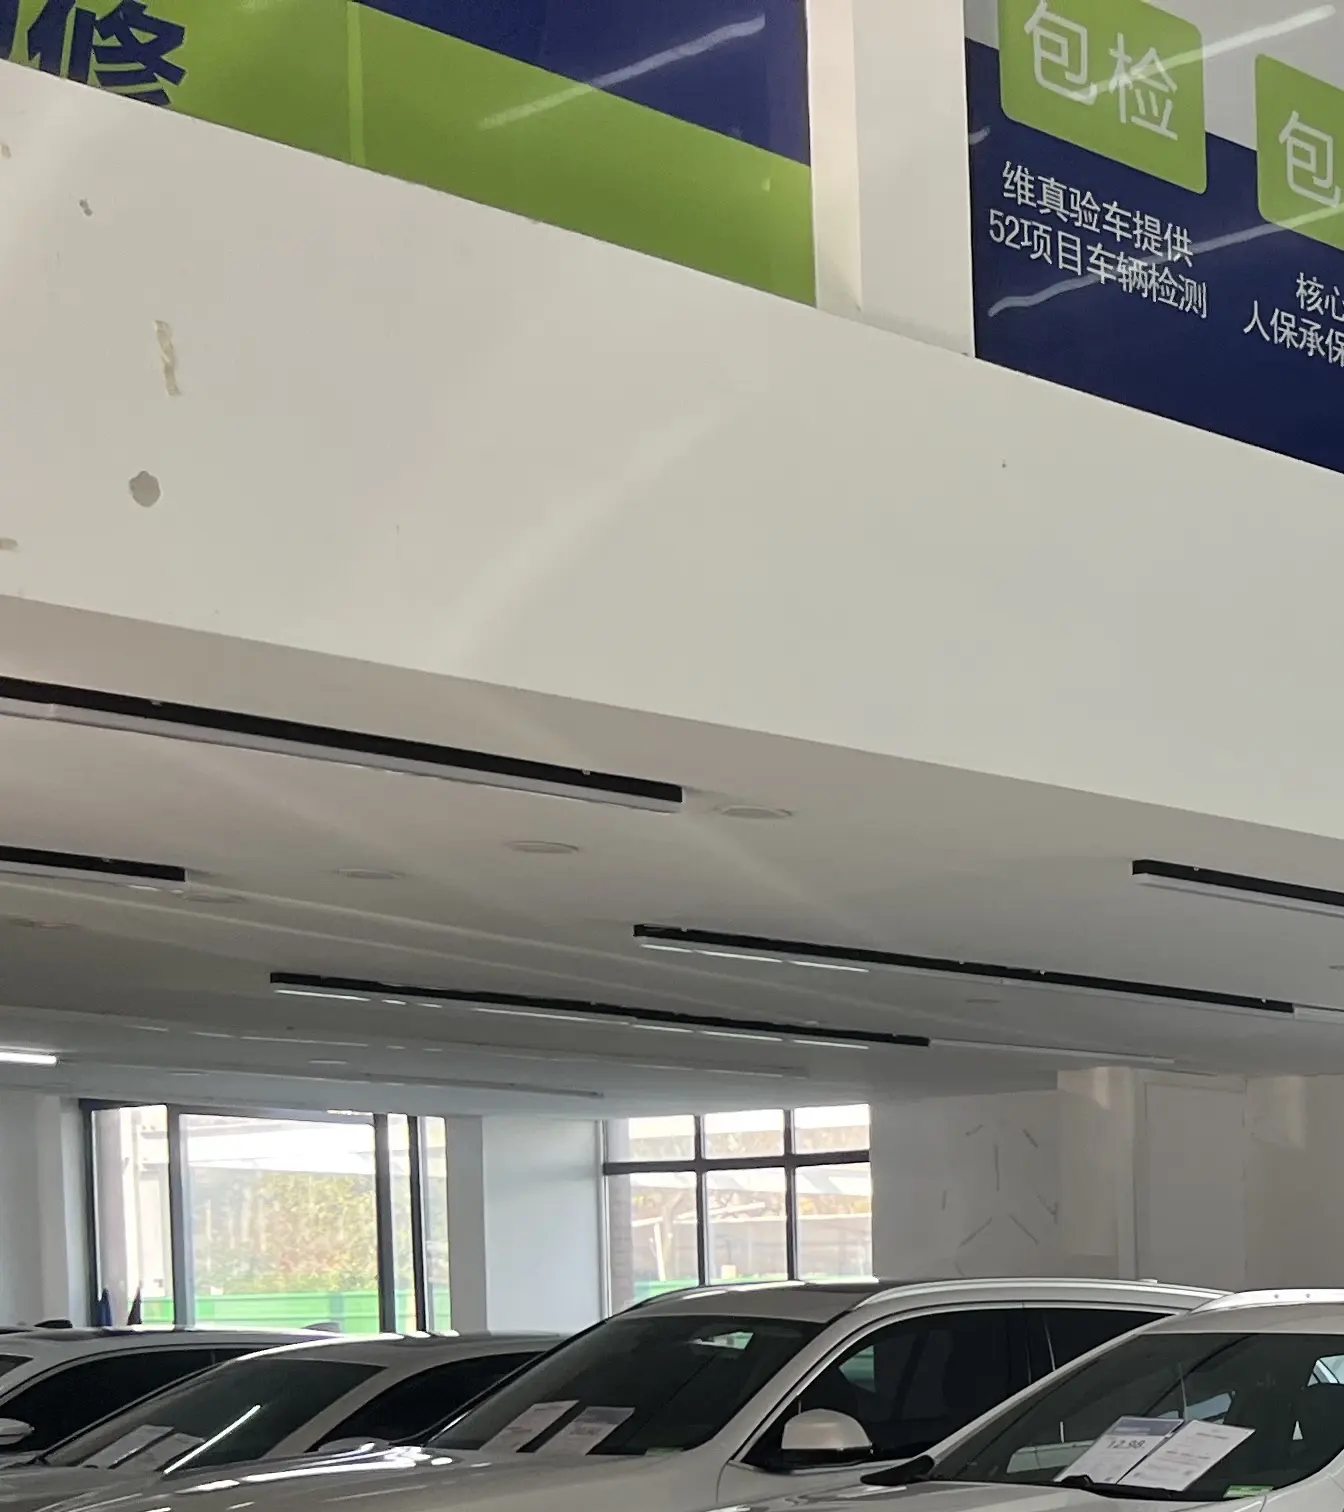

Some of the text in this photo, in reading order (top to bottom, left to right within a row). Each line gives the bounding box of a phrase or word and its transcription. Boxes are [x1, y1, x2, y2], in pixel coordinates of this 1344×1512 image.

[0, 0, 187, 105] 修
[1024, 0, 1178, 141] 包检
[989, 207, 1208, 319] 52项目车辆检测
[1002, 160, 1194, 268] 维真验车提供
